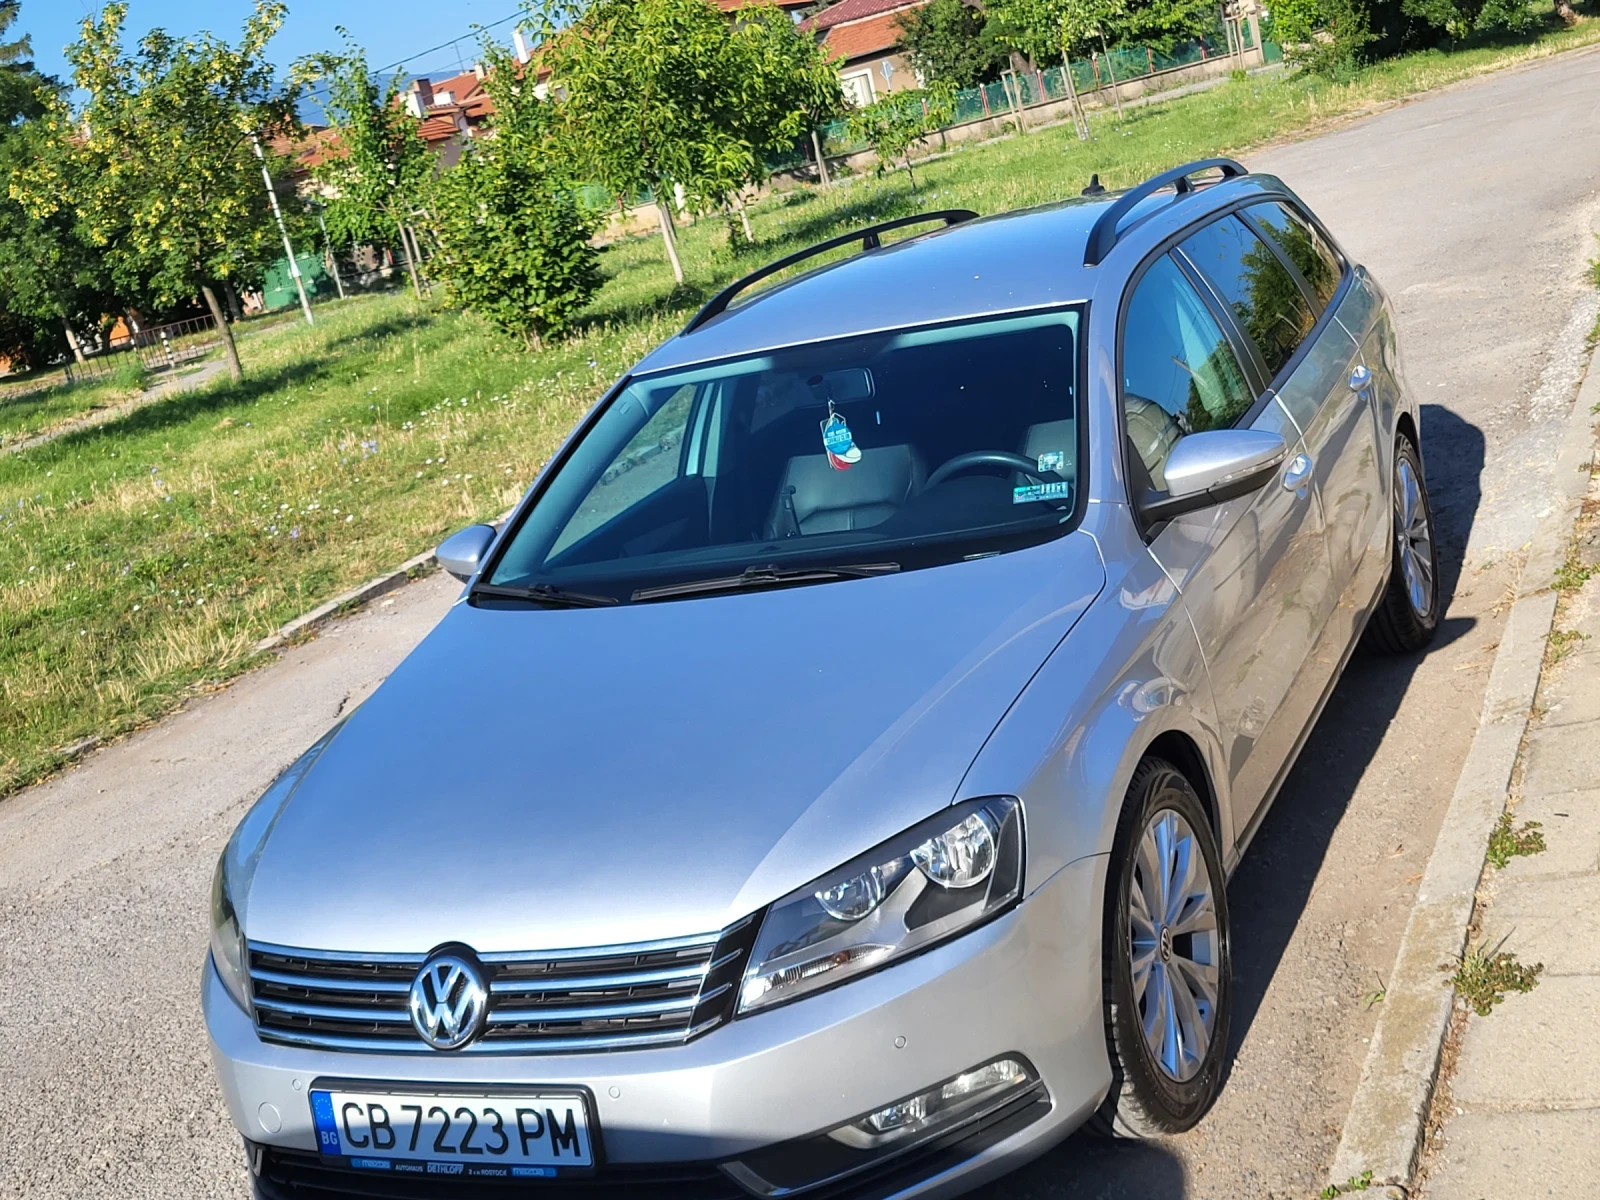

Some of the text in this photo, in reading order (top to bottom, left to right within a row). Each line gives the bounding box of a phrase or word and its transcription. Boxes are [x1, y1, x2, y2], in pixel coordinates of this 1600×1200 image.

[400, 1104, 510, 1155] 7223
[321, 1130, 338, 1145] BG
[427, 1161, 464, 1175] DETHLOFF
